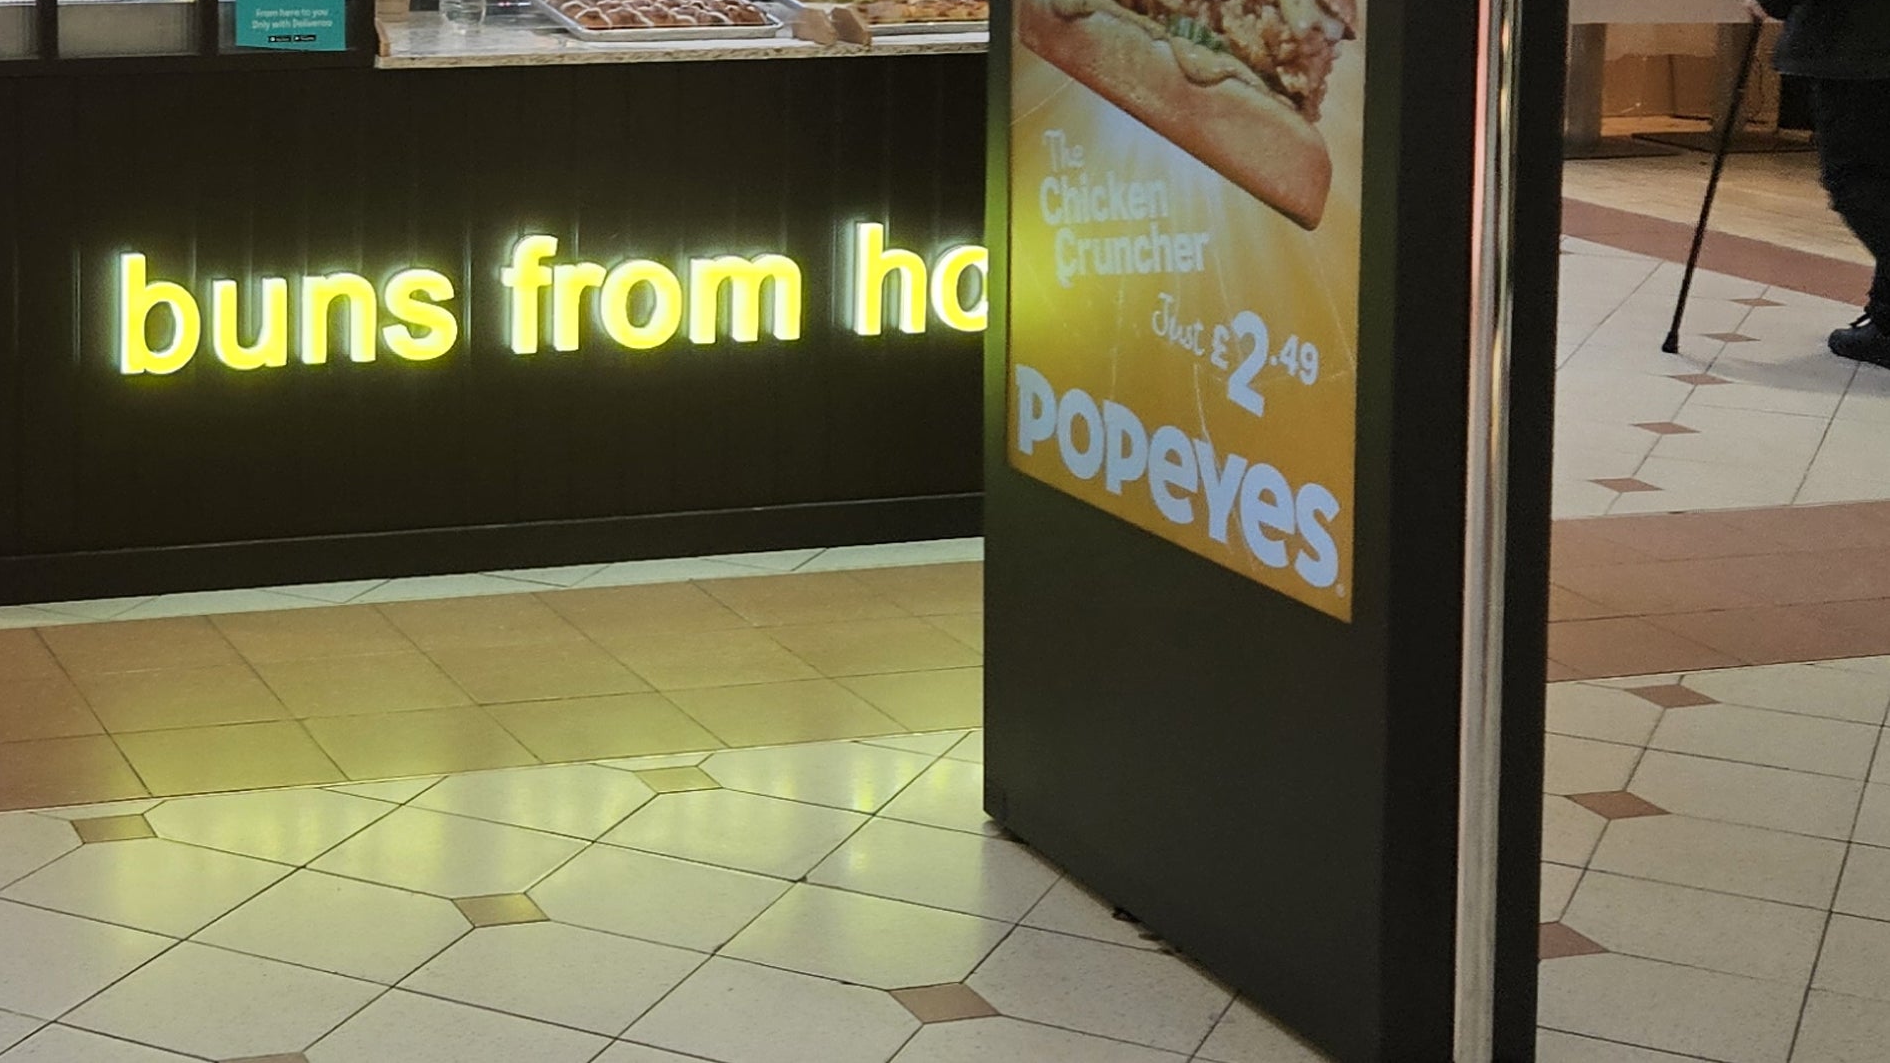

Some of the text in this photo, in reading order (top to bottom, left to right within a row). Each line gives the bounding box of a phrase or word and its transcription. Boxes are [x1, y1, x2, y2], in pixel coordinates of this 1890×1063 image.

[251, 20, 271, 31] Only
[272, 19, 291, 29] with
[255, 8, 329, 18] From here to you
[1042, 128, 1086, 172] The
[1039, 172, 1169, 228] Chicken
[1053, 226, 1210, 287] Cruncher
[118, 251, 459, 377] buns
[499, 233, 803, 355] from
[1151, 292, 1206, 358] Just
